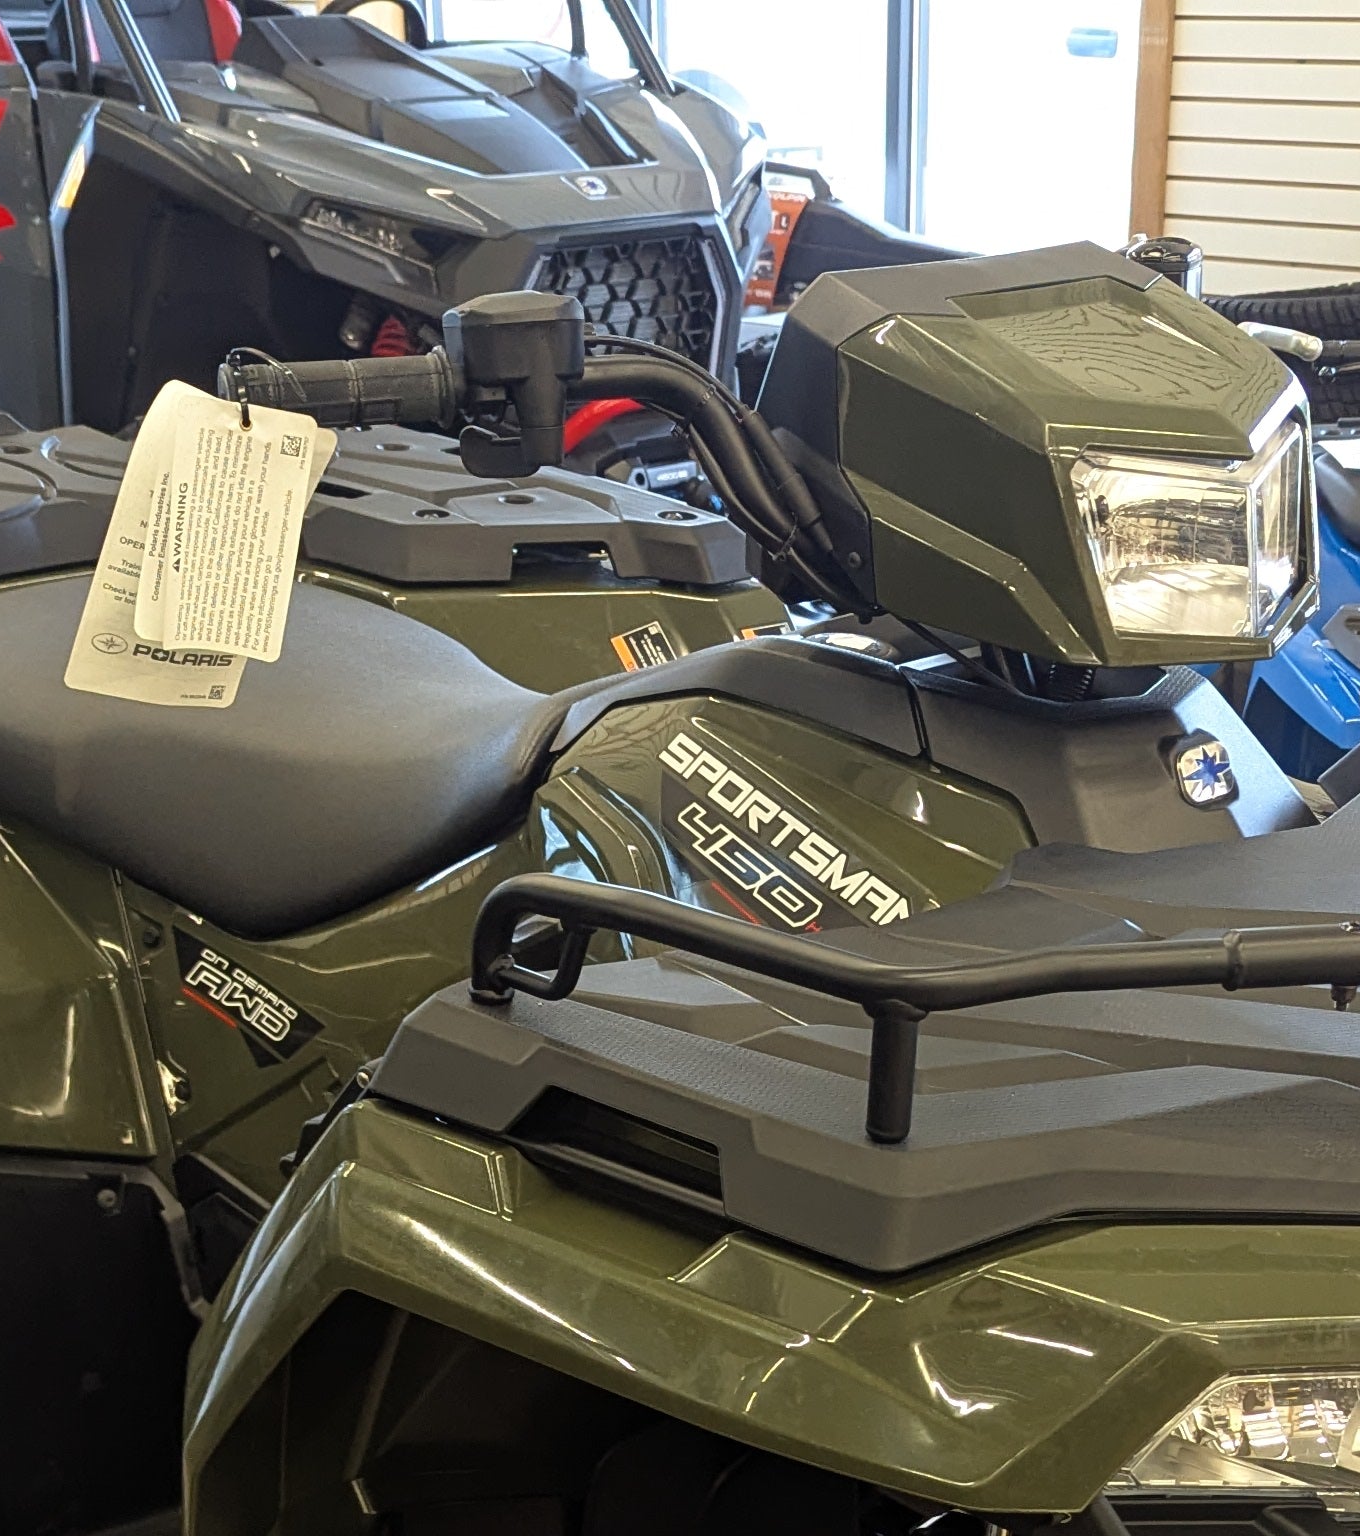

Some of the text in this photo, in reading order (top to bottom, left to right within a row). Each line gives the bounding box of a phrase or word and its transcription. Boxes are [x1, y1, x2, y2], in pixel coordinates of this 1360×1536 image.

[148, 472, 170, 557] Polaris Industries Inc.
[174, 482, 189, 557] WARNING
[102, 582, 127, 596] Check
[152, 560, 163, 601] Consumer
[158, 517, 170, 558] Emissions
[132, 643, 234, 667] POLARIS
[677, 802, 823, 928] 450
[185, 960, 291, 1042] AWD
[231, 968, 299, 1020] DEMAND
